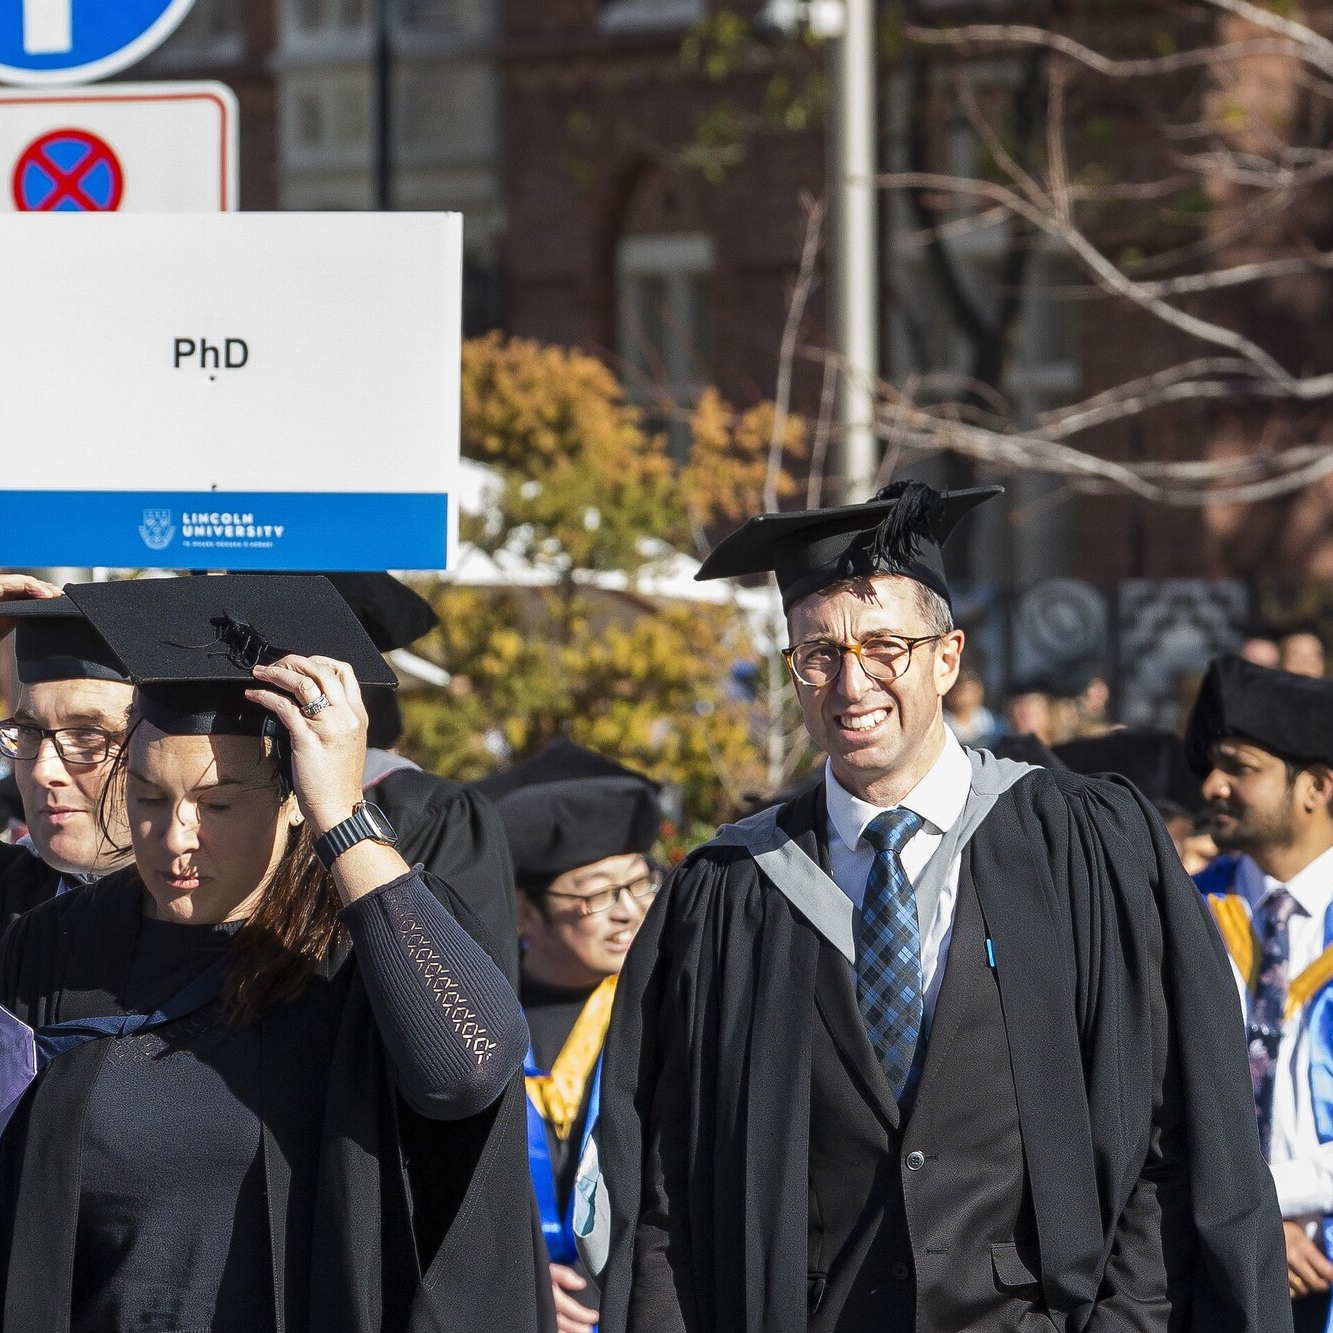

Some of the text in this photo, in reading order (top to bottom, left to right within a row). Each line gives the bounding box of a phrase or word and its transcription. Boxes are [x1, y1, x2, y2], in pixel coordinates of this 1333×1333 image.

[173, 338, 249, 369] PhD
[182, 512, 254, 525] LINCOLN
[182, 525, 285, 538] UNIVERSITY
